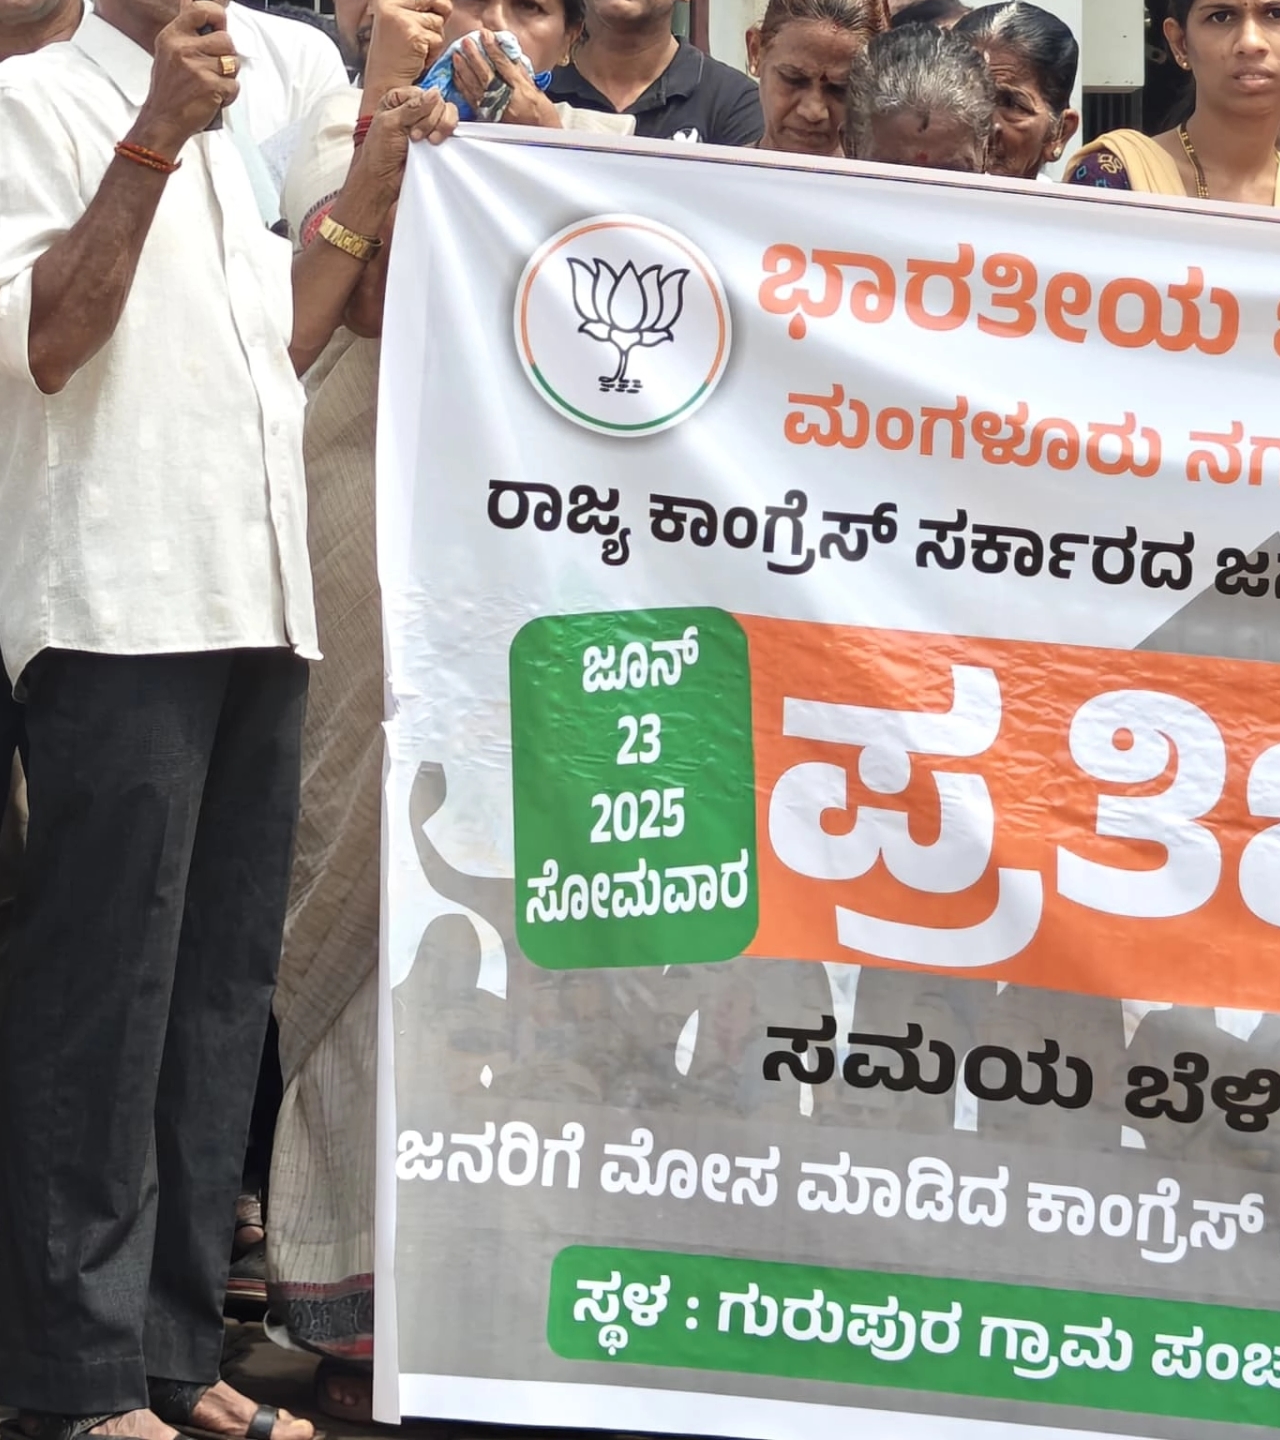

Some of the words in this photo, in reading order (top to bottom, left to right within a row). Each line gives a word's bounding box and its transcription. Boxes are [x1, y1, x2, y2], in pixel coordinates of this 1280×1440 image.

[757, 243, 1239, 356] ಭಾರತೀಯ
[783, 383, 1163, 478] ಮಂಗಳೂರು
[487, 478, 631, 566] ರಾಜ್ಯ
[648, 489, 899, 574] ಕಾಂಗ್ರೆಸ್
[915, 509, 1195, 591] ಸರ್ಕಾರದ
[581, 625, 700, 694] ಜೂನ್
[616, 712, 663, 765] 23
[589, 787, 686, 843] 2025
[524, 848, 750, 924] ಸೋಮವಾರ
[762, 1014, 1094, 1111] ಸಮಯ
[394, 1121, 585, 1190] ಜನರಿಗೆ
[599, 1127, 781, 1207] ಮೋಸ
[795, 1151, 1008, 1228] ಮಾಡಿದ
[1025, 1177, 1265, 1264] ಕಾಂಗ್ರೆಸ್
[572, 1270, 671, 1356] ಸ್ಥಳ
[717, 1282, 963, 1363] ಗುರುಪುರ
[978, 1314, 1133, 1379] ಗ್ರಾಮ
